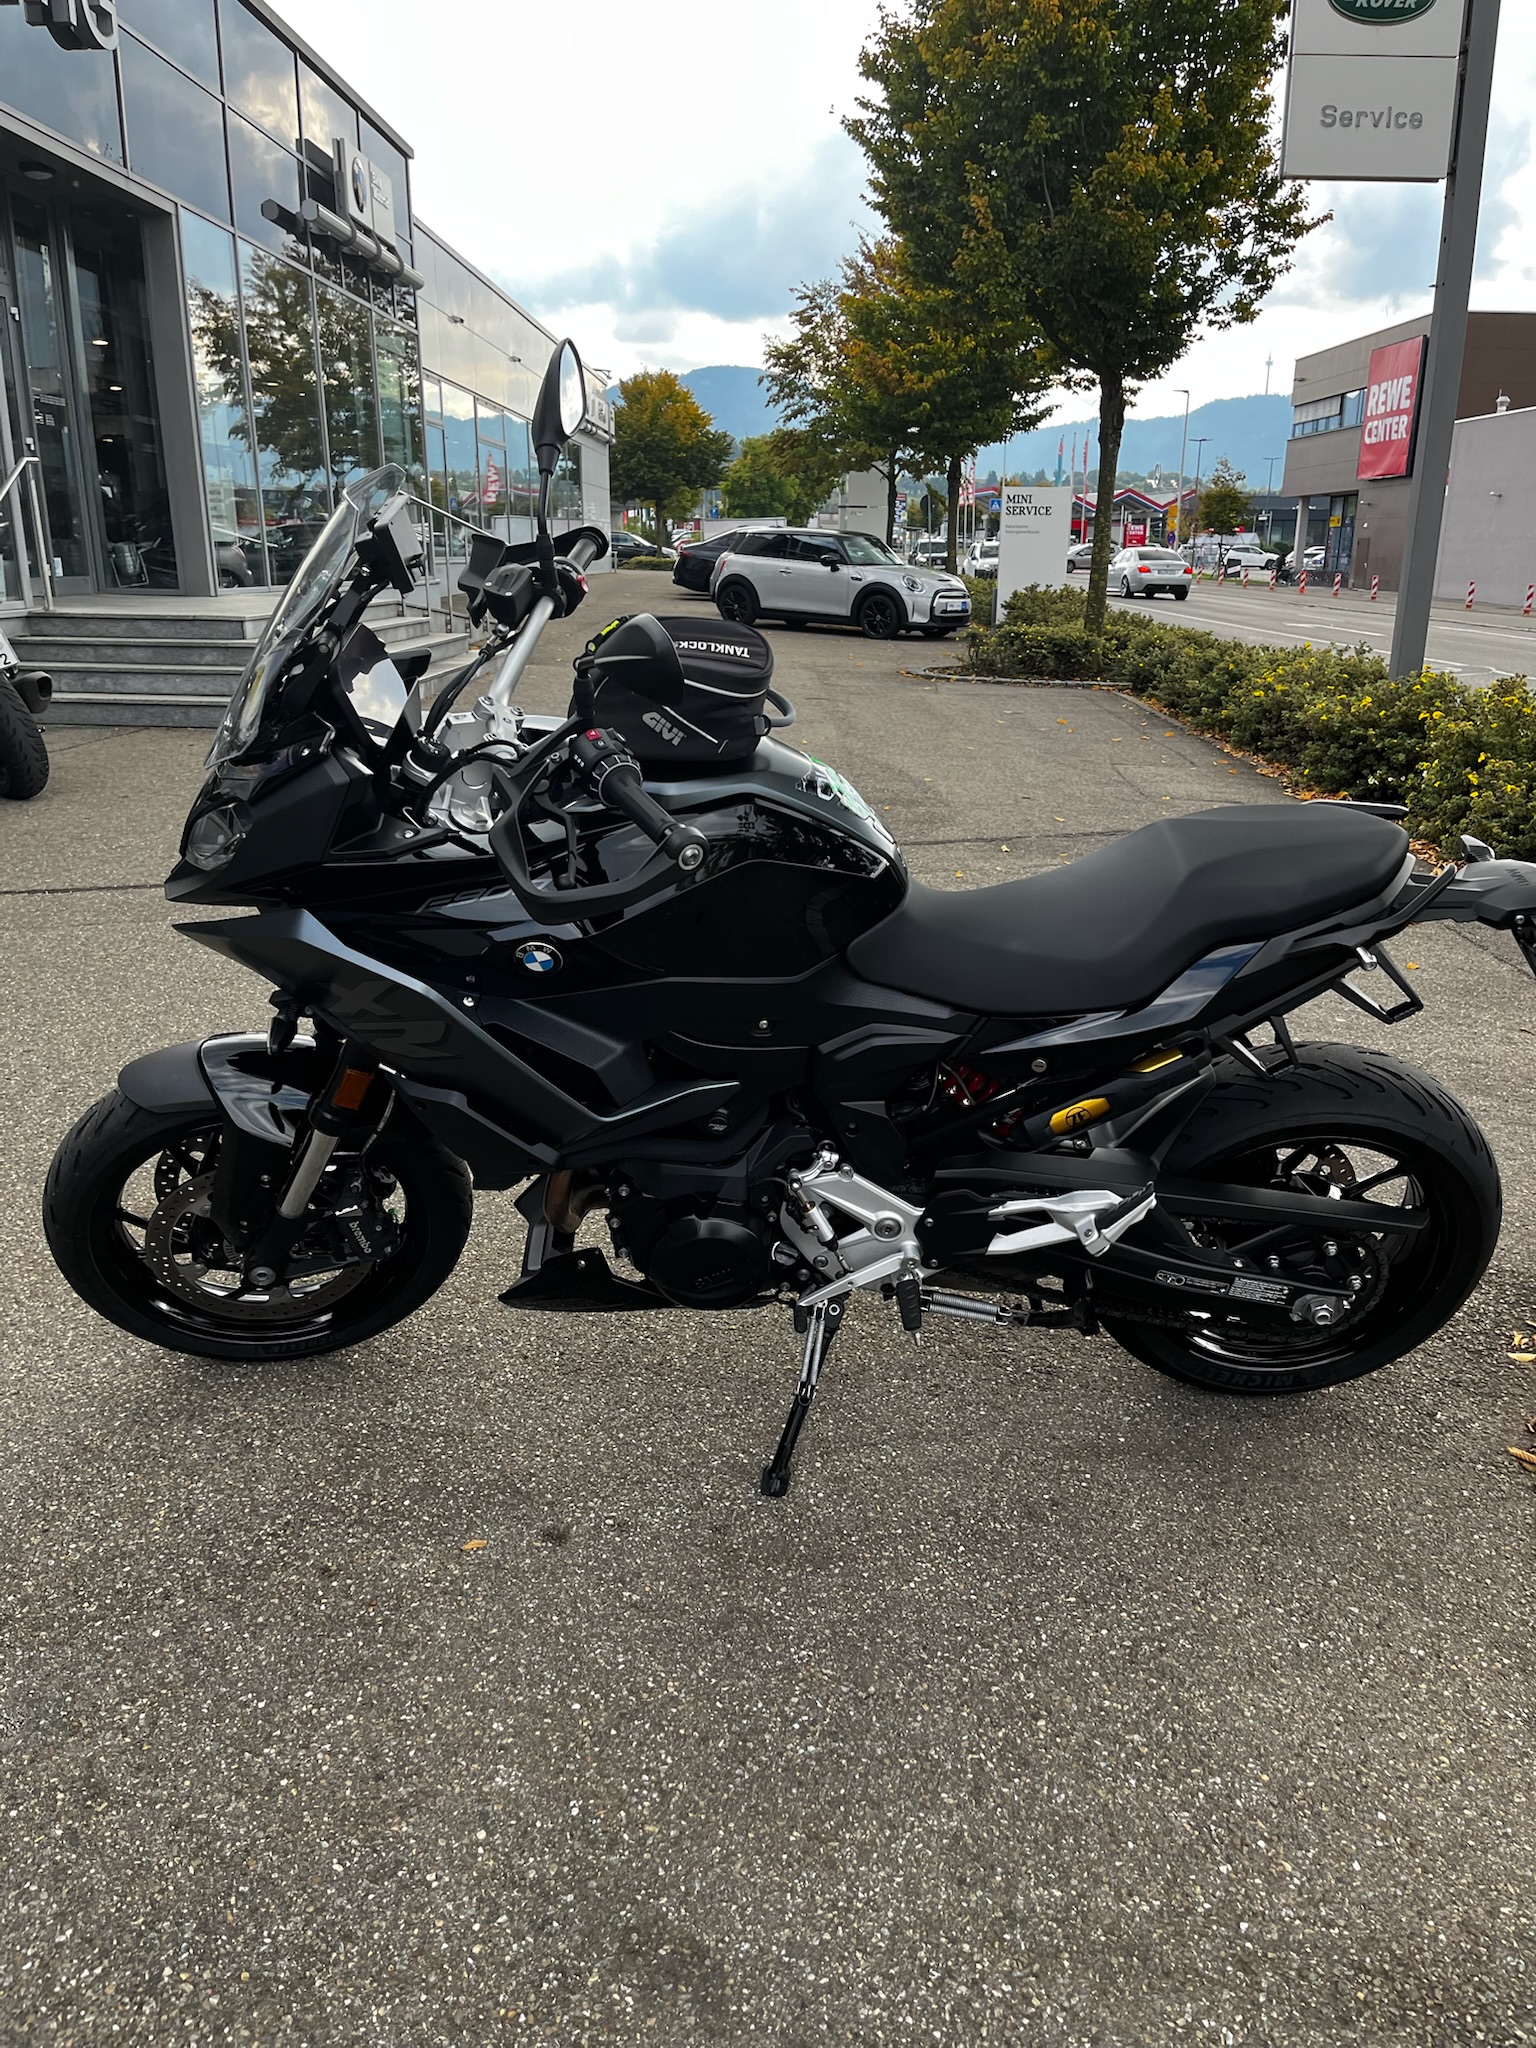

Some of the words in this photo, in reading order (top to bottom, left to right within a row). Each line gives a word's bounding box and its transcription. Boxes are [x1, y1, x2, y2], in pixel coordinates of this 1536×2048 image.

[1320, 105, 1423, 129] Service
[1367, 375, 1413, 416] REWE
[1364, 414, 1408, 444] CENTER
[1005, 505, 1052, 516] SERVICE
[1006, 494, 1033, 504] MINI
[642, 711, 684, 747] GIVI
[515, 945, 553, 959] BMW
[349, 1221, 372, 1254] brembo
